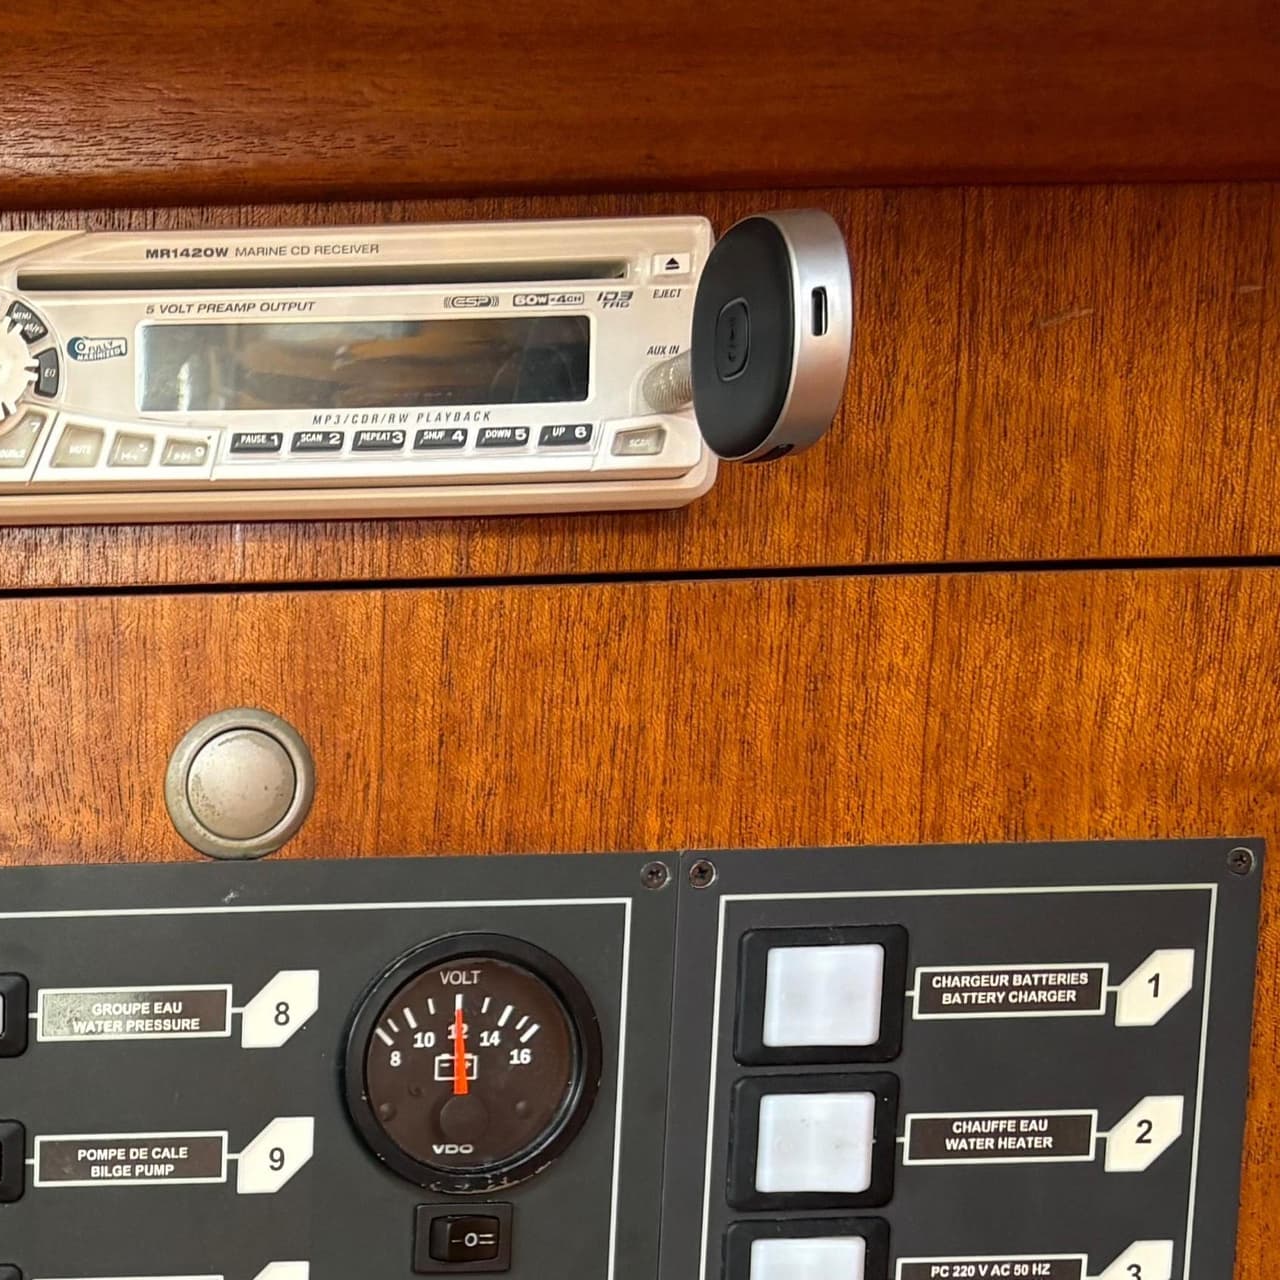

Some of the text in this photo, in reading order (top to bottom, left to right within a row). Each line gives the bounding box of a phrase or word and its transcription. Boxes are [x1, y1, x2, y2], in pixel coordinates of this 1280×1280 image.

[146, 244, 379, 259] MR1420W MARINE CD RECEIVER
[653, 289, 682, 298] EJECT
[146, 301, 316, 314] 5 VOLT PREAMP OUTPUT
[441, 971, 480, 985] VOLT
[932, 973, 1088, 988] CHARGEUR BATTERIES
[1148, 973, 1160, 998] 1
[942, 990, 1076, 1004] BATTERY CHARGER
[92, 1002, 182, 1016] GROUPE EAU
[274, 1002, 289, 1025] 8
[72, 1019, 200, 1033] WATER PRESSURE
[414, 1033, 434, 1048] 10
[480, 1032, 499, 1046] 14
[390, 1052, 401, 1066] 8
[510, 1050, 531, 1064] 16
[953, 1120, 1048, 1134] CHAUFFE EAU
[1136, 1120, 1153, 1144] 2
[433, 1144, 473, 1154] VDO
[946, 1137, 1053, 1150] WATER HEATER
[78, 1147, 188, 1161] POMPE DE CALE
[269, 1147, 284, 1170] 9
[91, 1164, 174, 1177] BILGE PUMP
[931, 1264, 1050, 1278] PC 220 V AC 50 HZ
